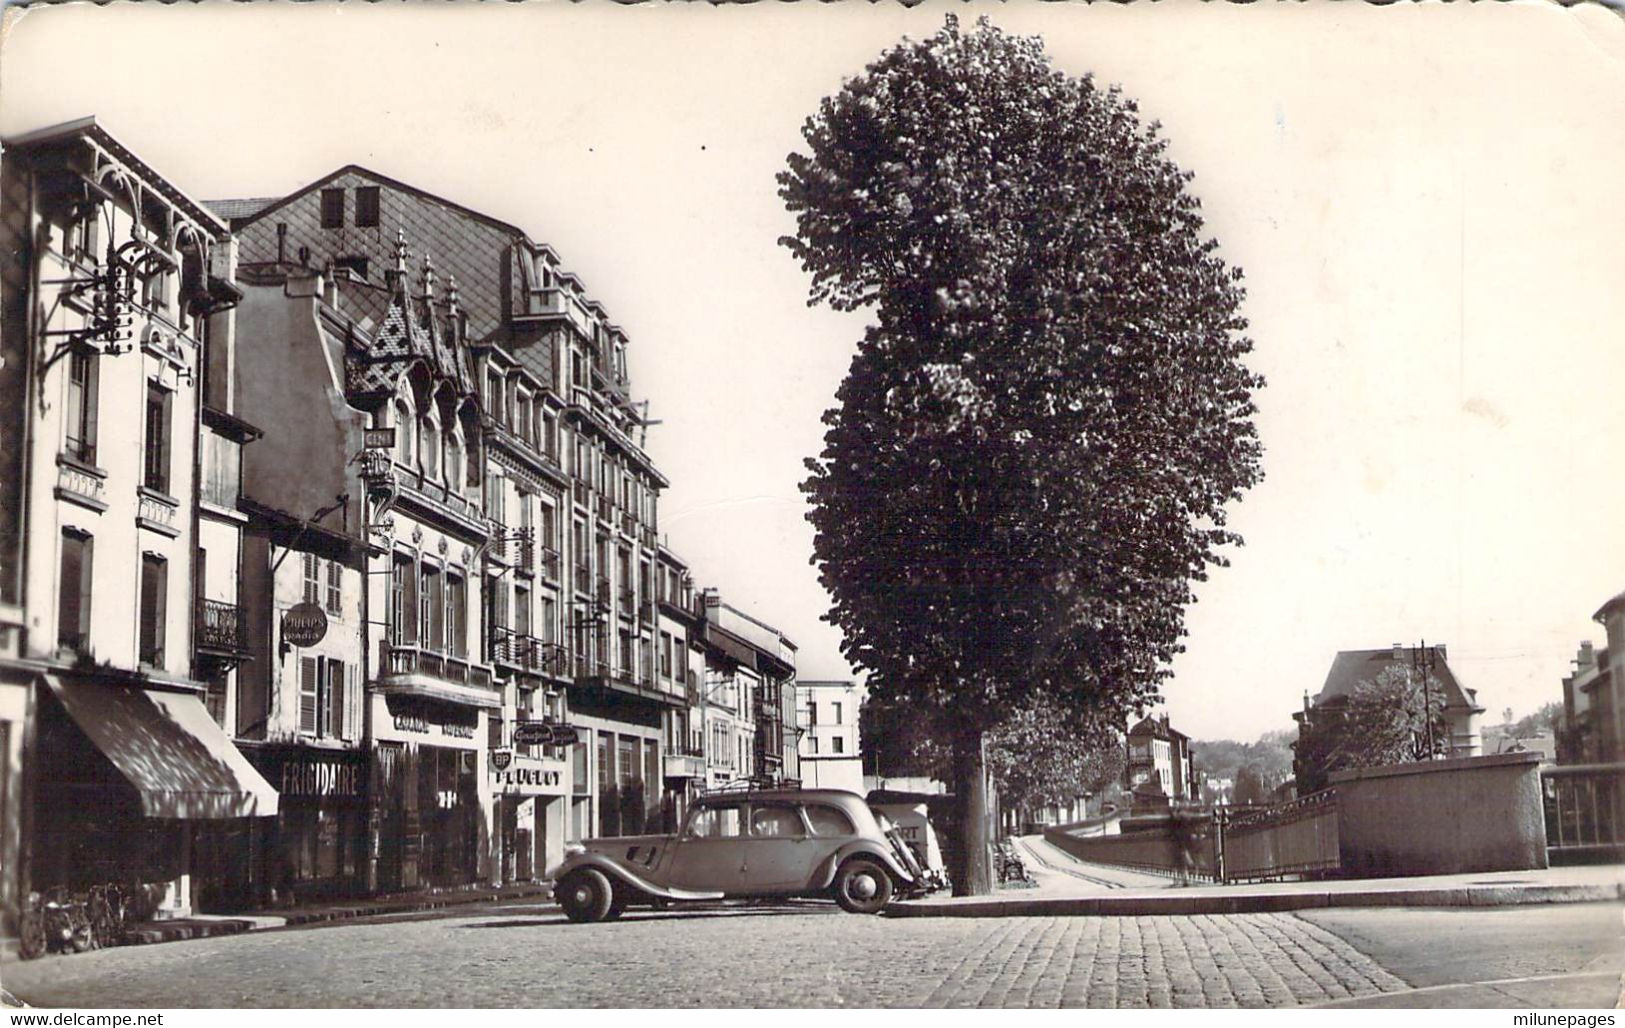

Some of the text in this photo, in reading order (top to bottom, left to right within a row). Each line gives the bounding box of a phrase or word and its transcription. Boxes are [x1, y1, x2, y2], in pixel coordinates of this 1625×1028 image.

[284, 616, 324, 629] PHILIPS
[496, 754, 509, 766] BP
[282, 762, 358, 796] FRIGIDAIRE
